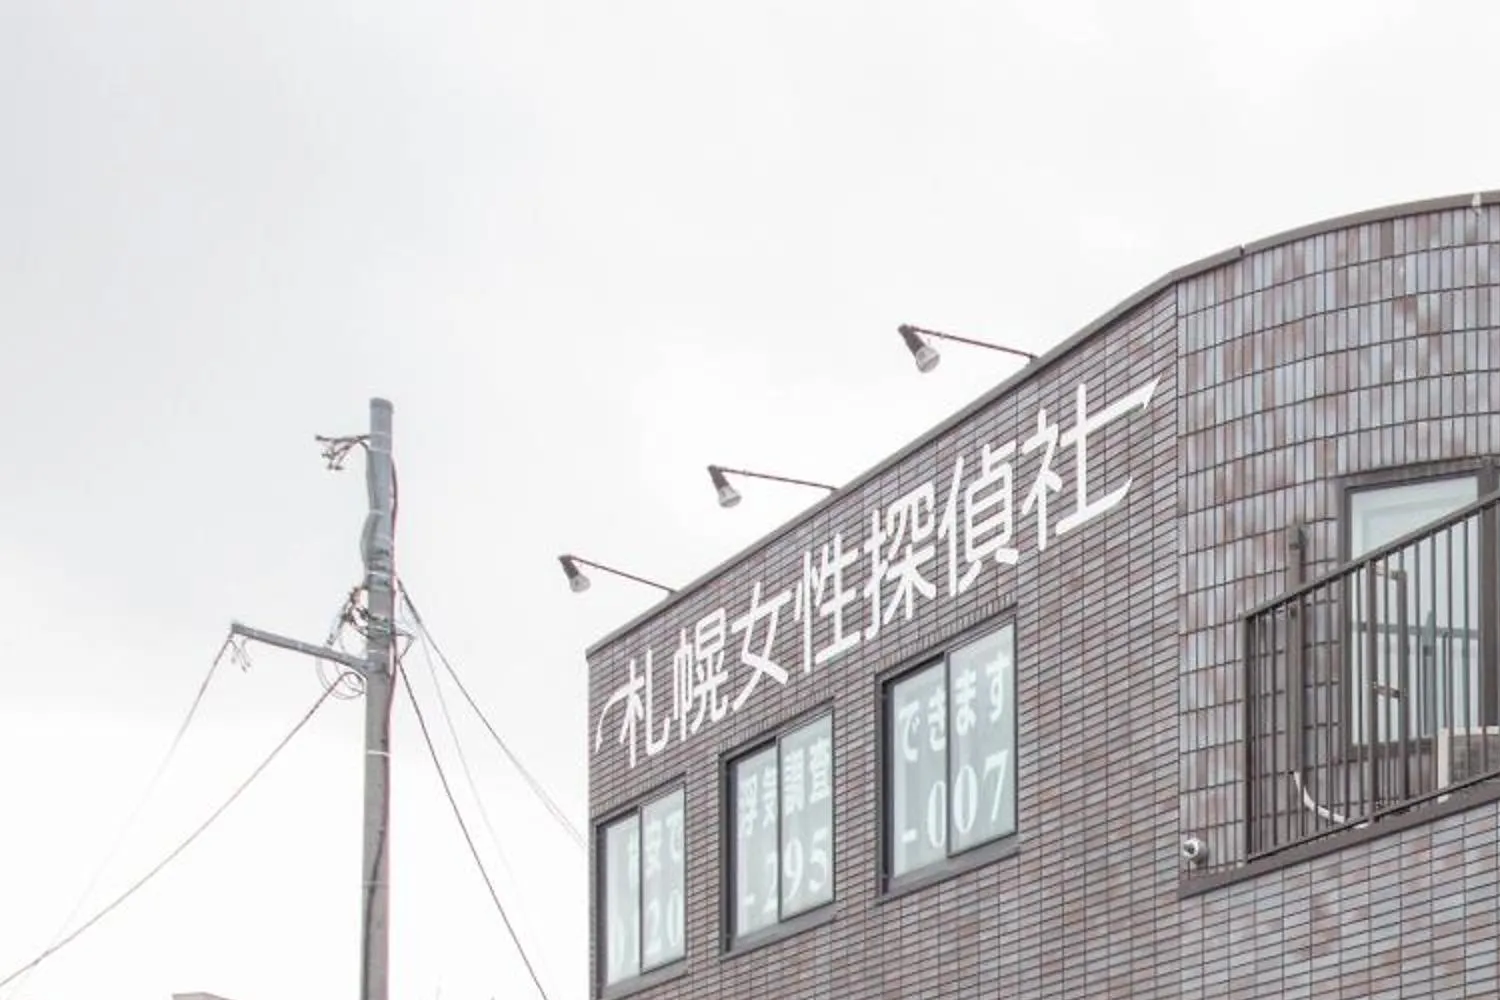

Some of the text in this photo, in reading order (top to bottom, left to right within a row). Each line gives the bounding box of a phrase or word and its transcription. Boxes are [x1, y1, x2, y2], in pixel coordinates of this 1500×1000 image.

[595, 376, 1162, 768] 札幌女性探偵社
[898, 651, 1011, 763] できます
